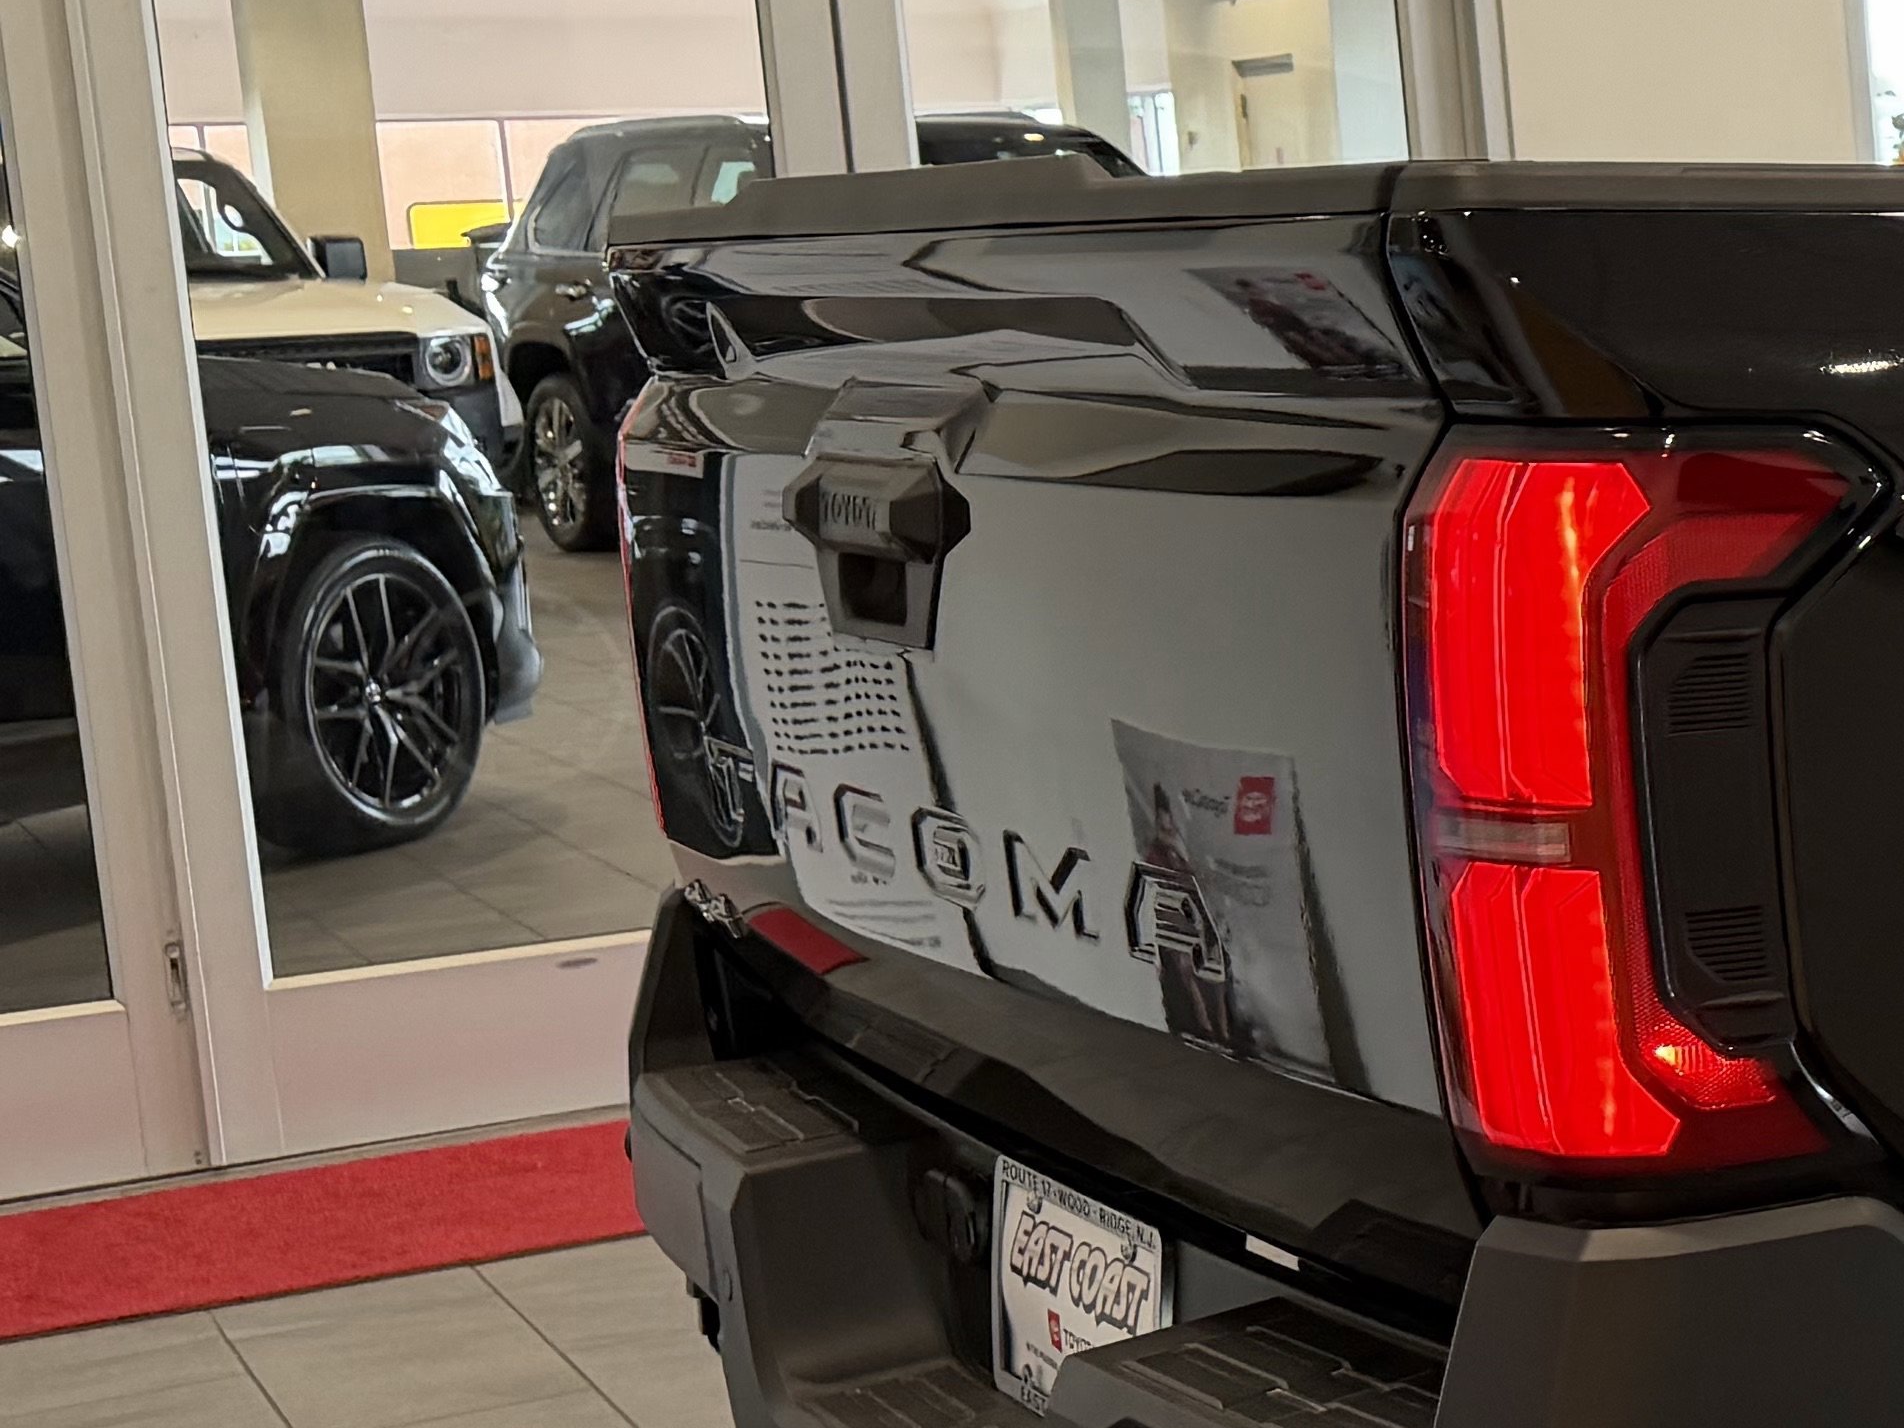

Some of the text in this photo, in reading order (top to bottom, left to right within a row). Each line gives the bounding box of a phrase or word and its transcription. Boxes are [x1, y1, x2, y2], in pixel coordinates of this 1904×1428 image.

[703, 735, 1229, 983] TACOMA
[1002, 1159, 1041, 1193] ROUTE
[1010, 1209, 1151, 1338] EAST COAST
